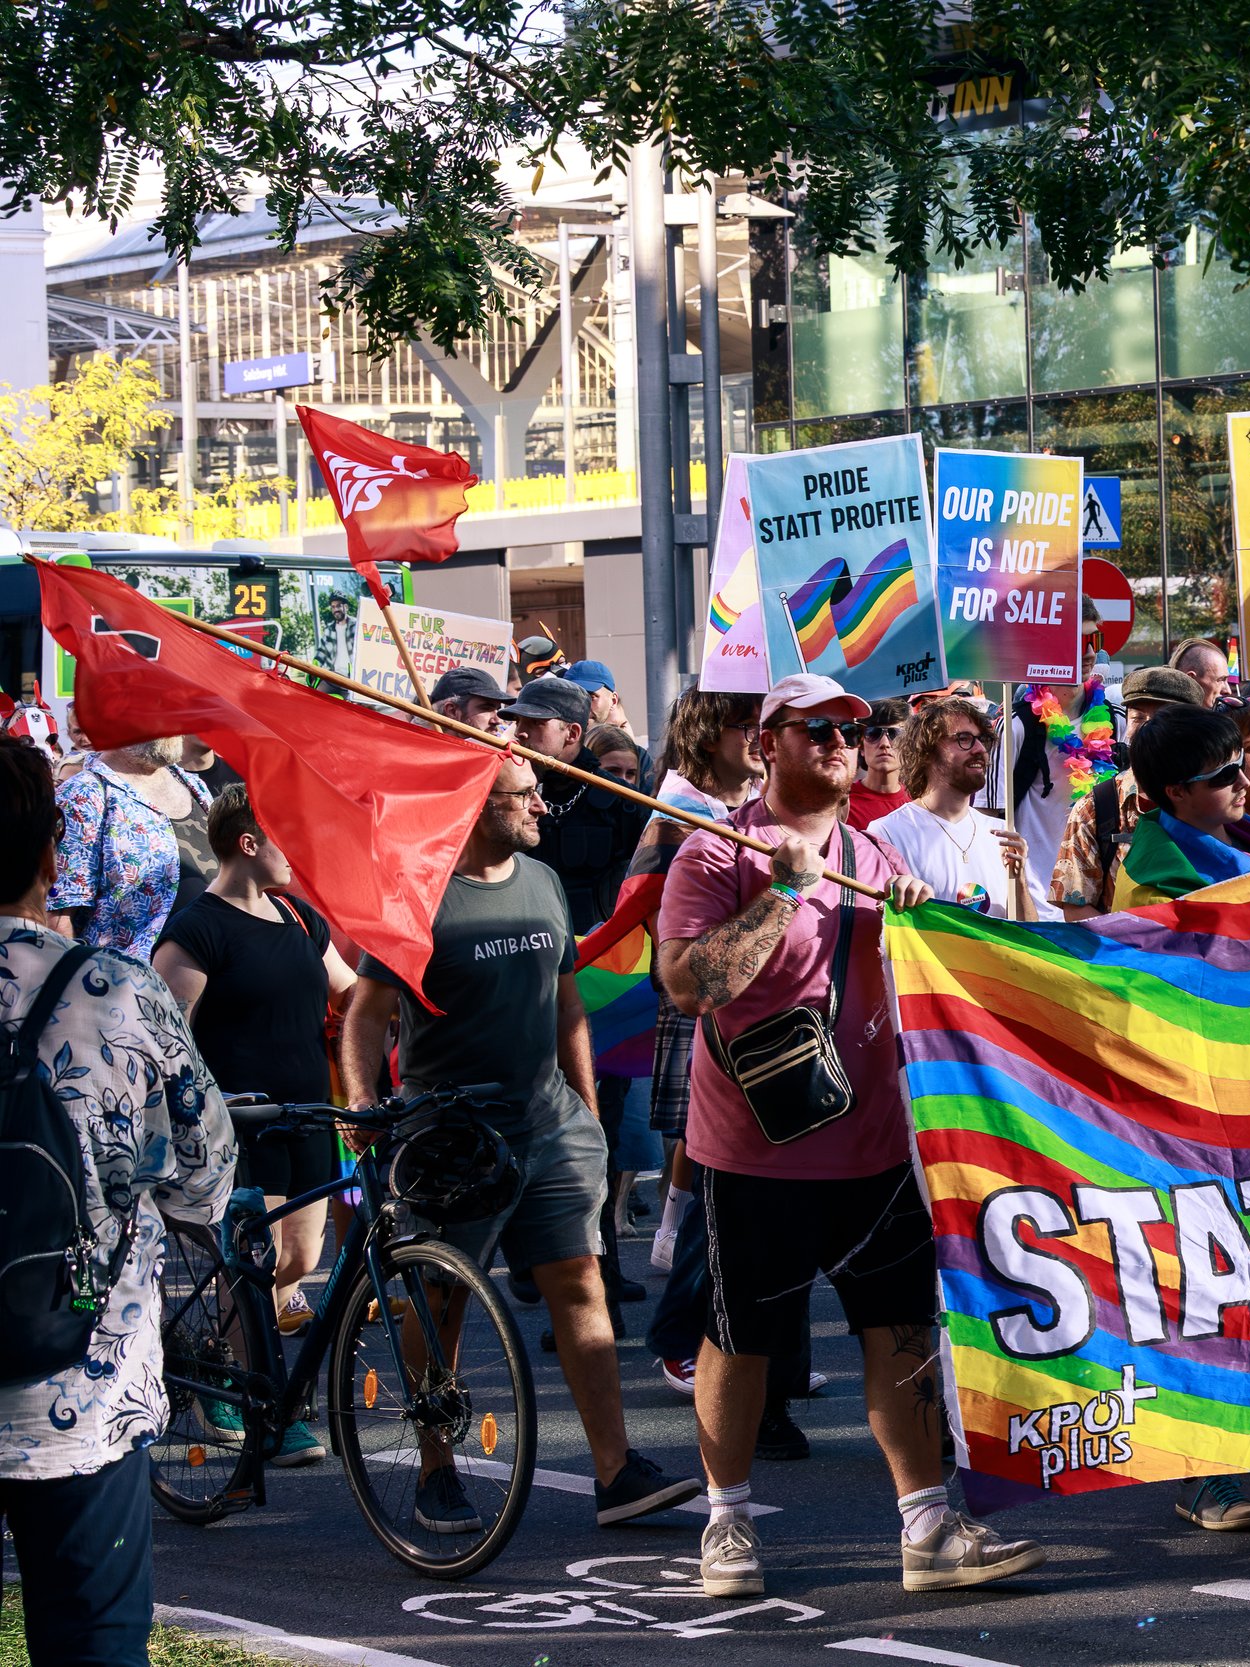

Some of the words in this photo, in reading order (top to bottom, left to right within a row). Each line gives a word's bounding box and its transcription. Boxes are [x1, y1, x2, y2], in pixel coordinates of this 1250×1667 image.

[803, 466, 871, 501] PRIDE
[759, 510, 823, 544] STATT
[832, 495, 922, 534] PROFITE
[942, 486, 994, 522] OUR
[1000, 489, 1075, 527] PRIDE
[967, 537, 993, 572] IS
[999, 538, 1050, 575] NOT
[234, 584, 267, 616] 25
[949, 586, 998, 623] FOR
[1004, 589, 1066, 625] SALE
[408, 612, 445, 635] FÜR
[904, 670, 928, 688] plus
[474, 932, 554, 960] ANTIBASTI
[1039, 1431, 1133, 1490] plus
